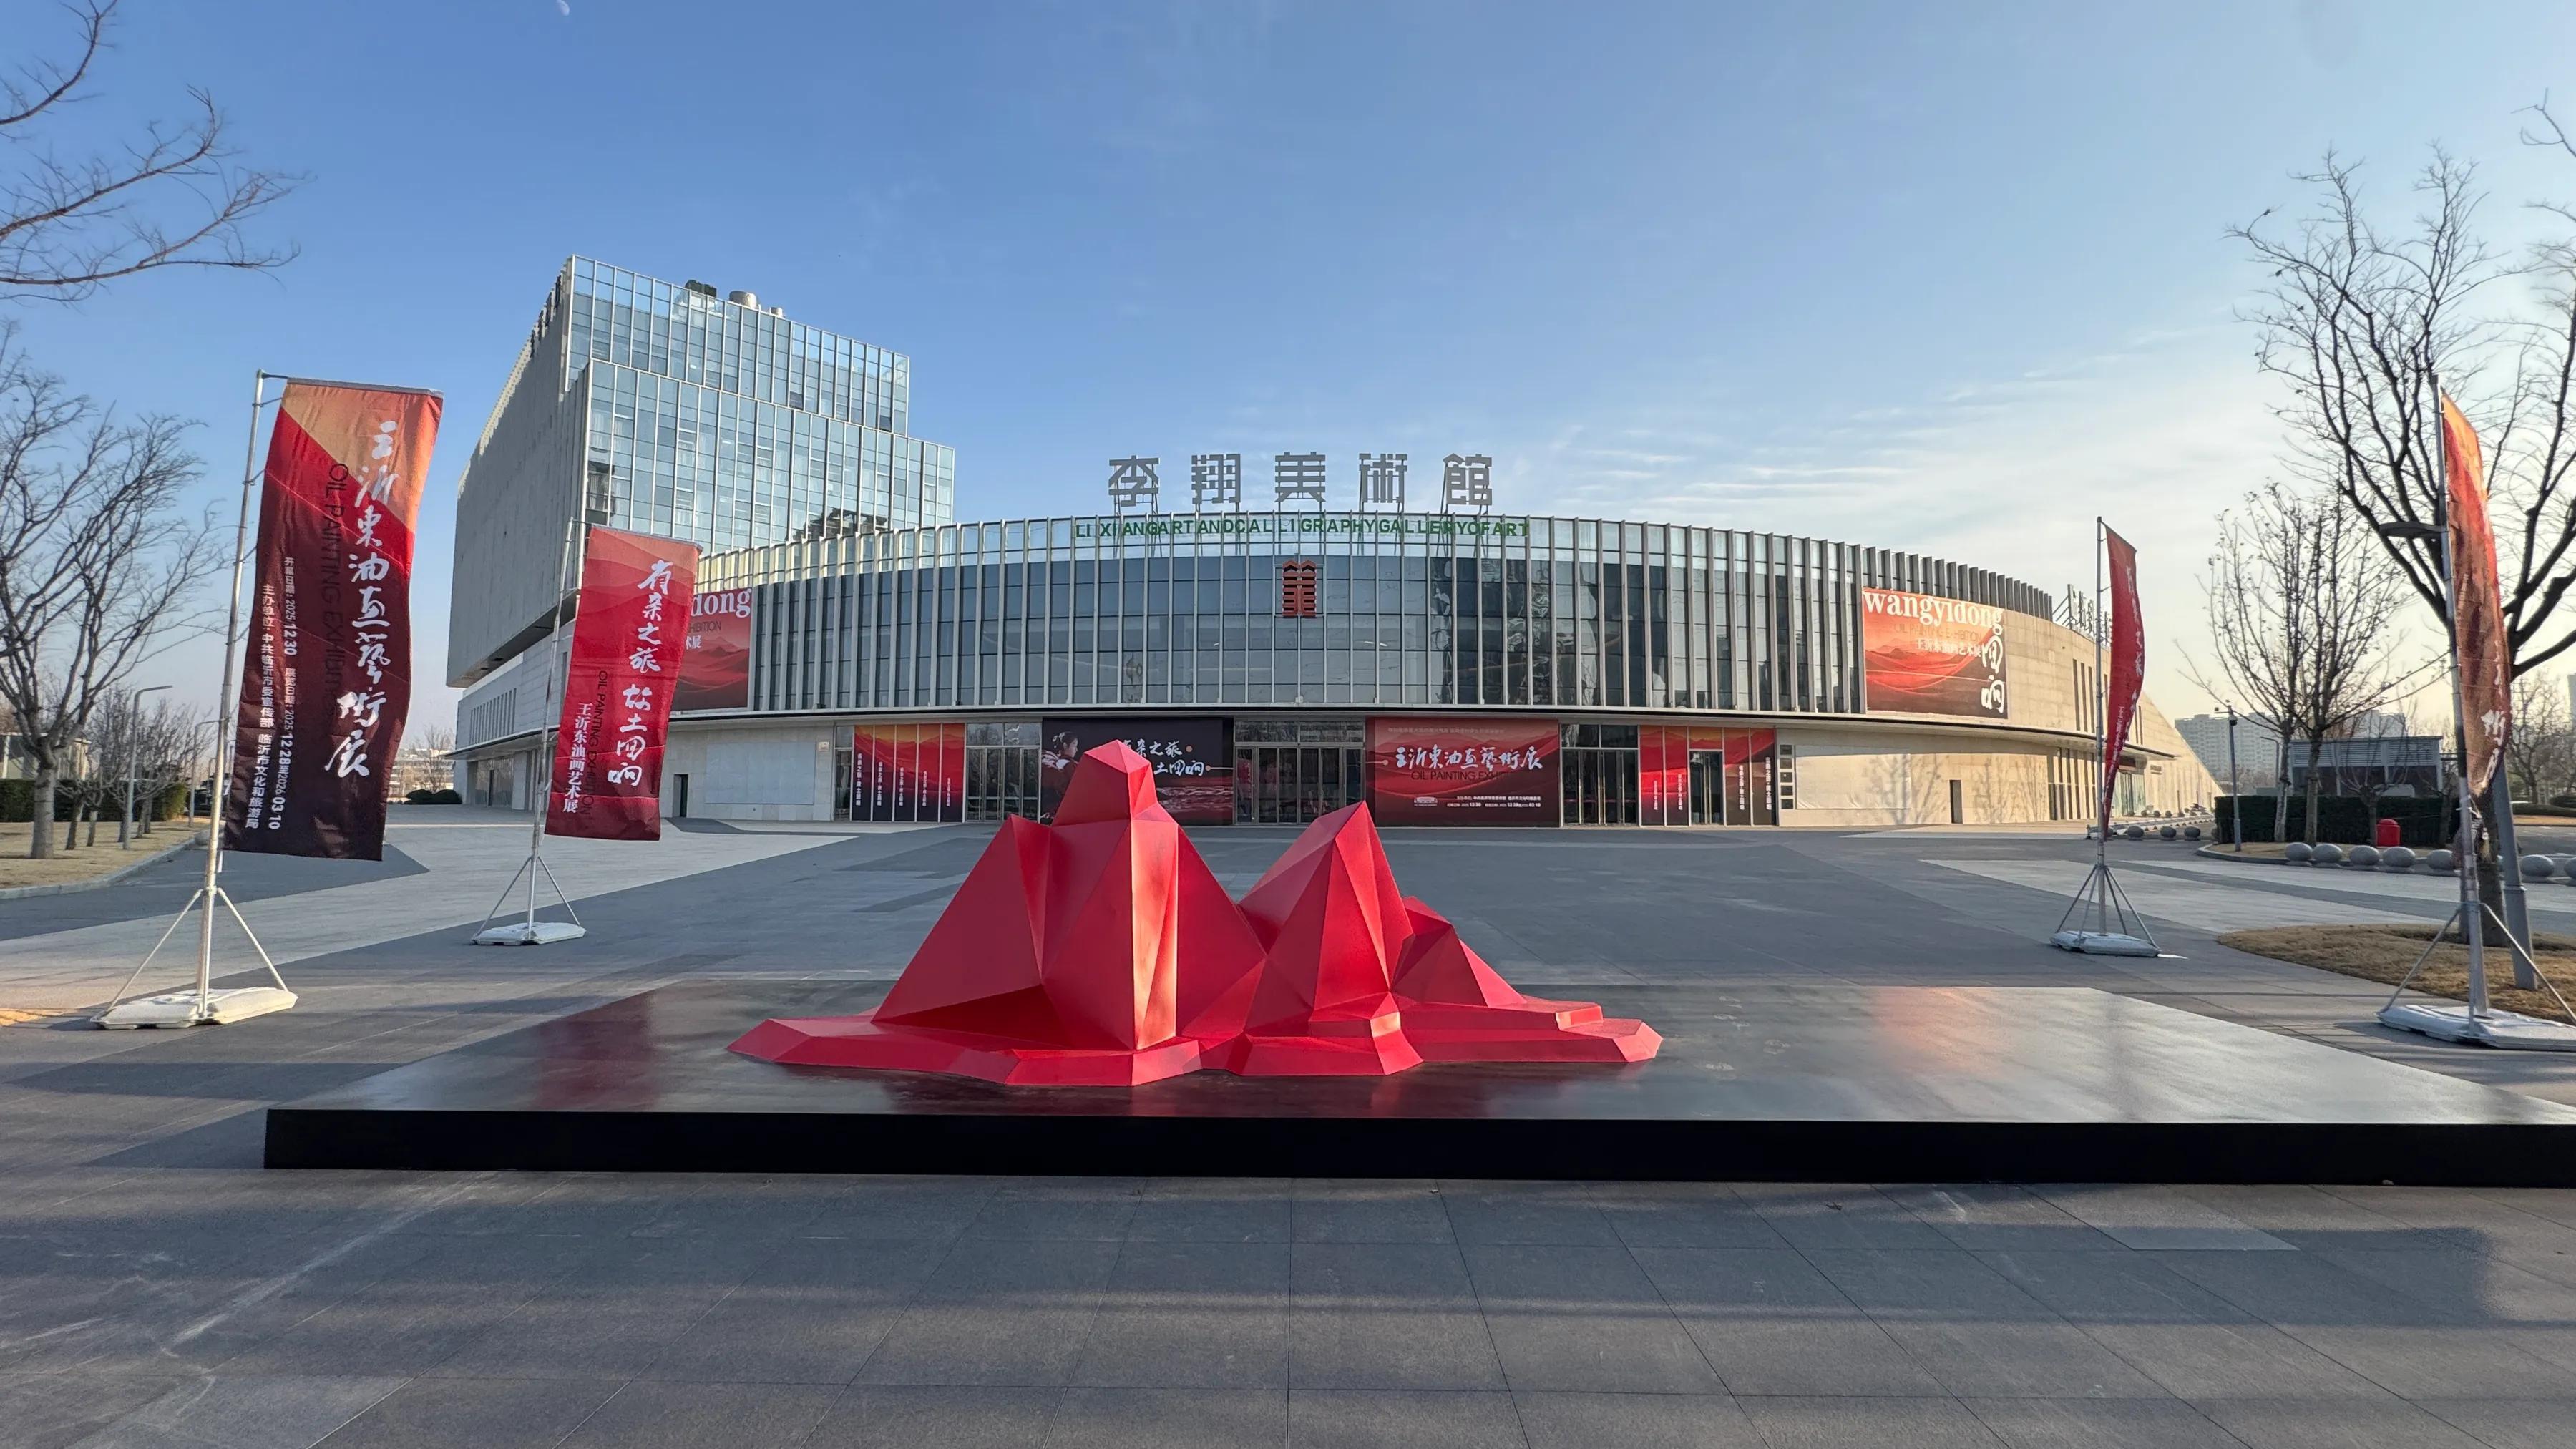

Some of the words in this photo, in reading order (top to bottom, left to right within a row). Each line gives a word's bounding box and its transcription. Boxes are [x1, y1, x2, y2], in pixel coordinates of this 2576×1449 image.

[326, 463, 349, 499] OIL
[1108, 452, 1493, 507] 李翔美術館
[597, 670, 608, 691] OIL
[562, 702, 593, 814] 王沂东油画艺术展
[1411, 771, 1428, 780] OIL
[1430, 771, 1476, 780] PAINTING
